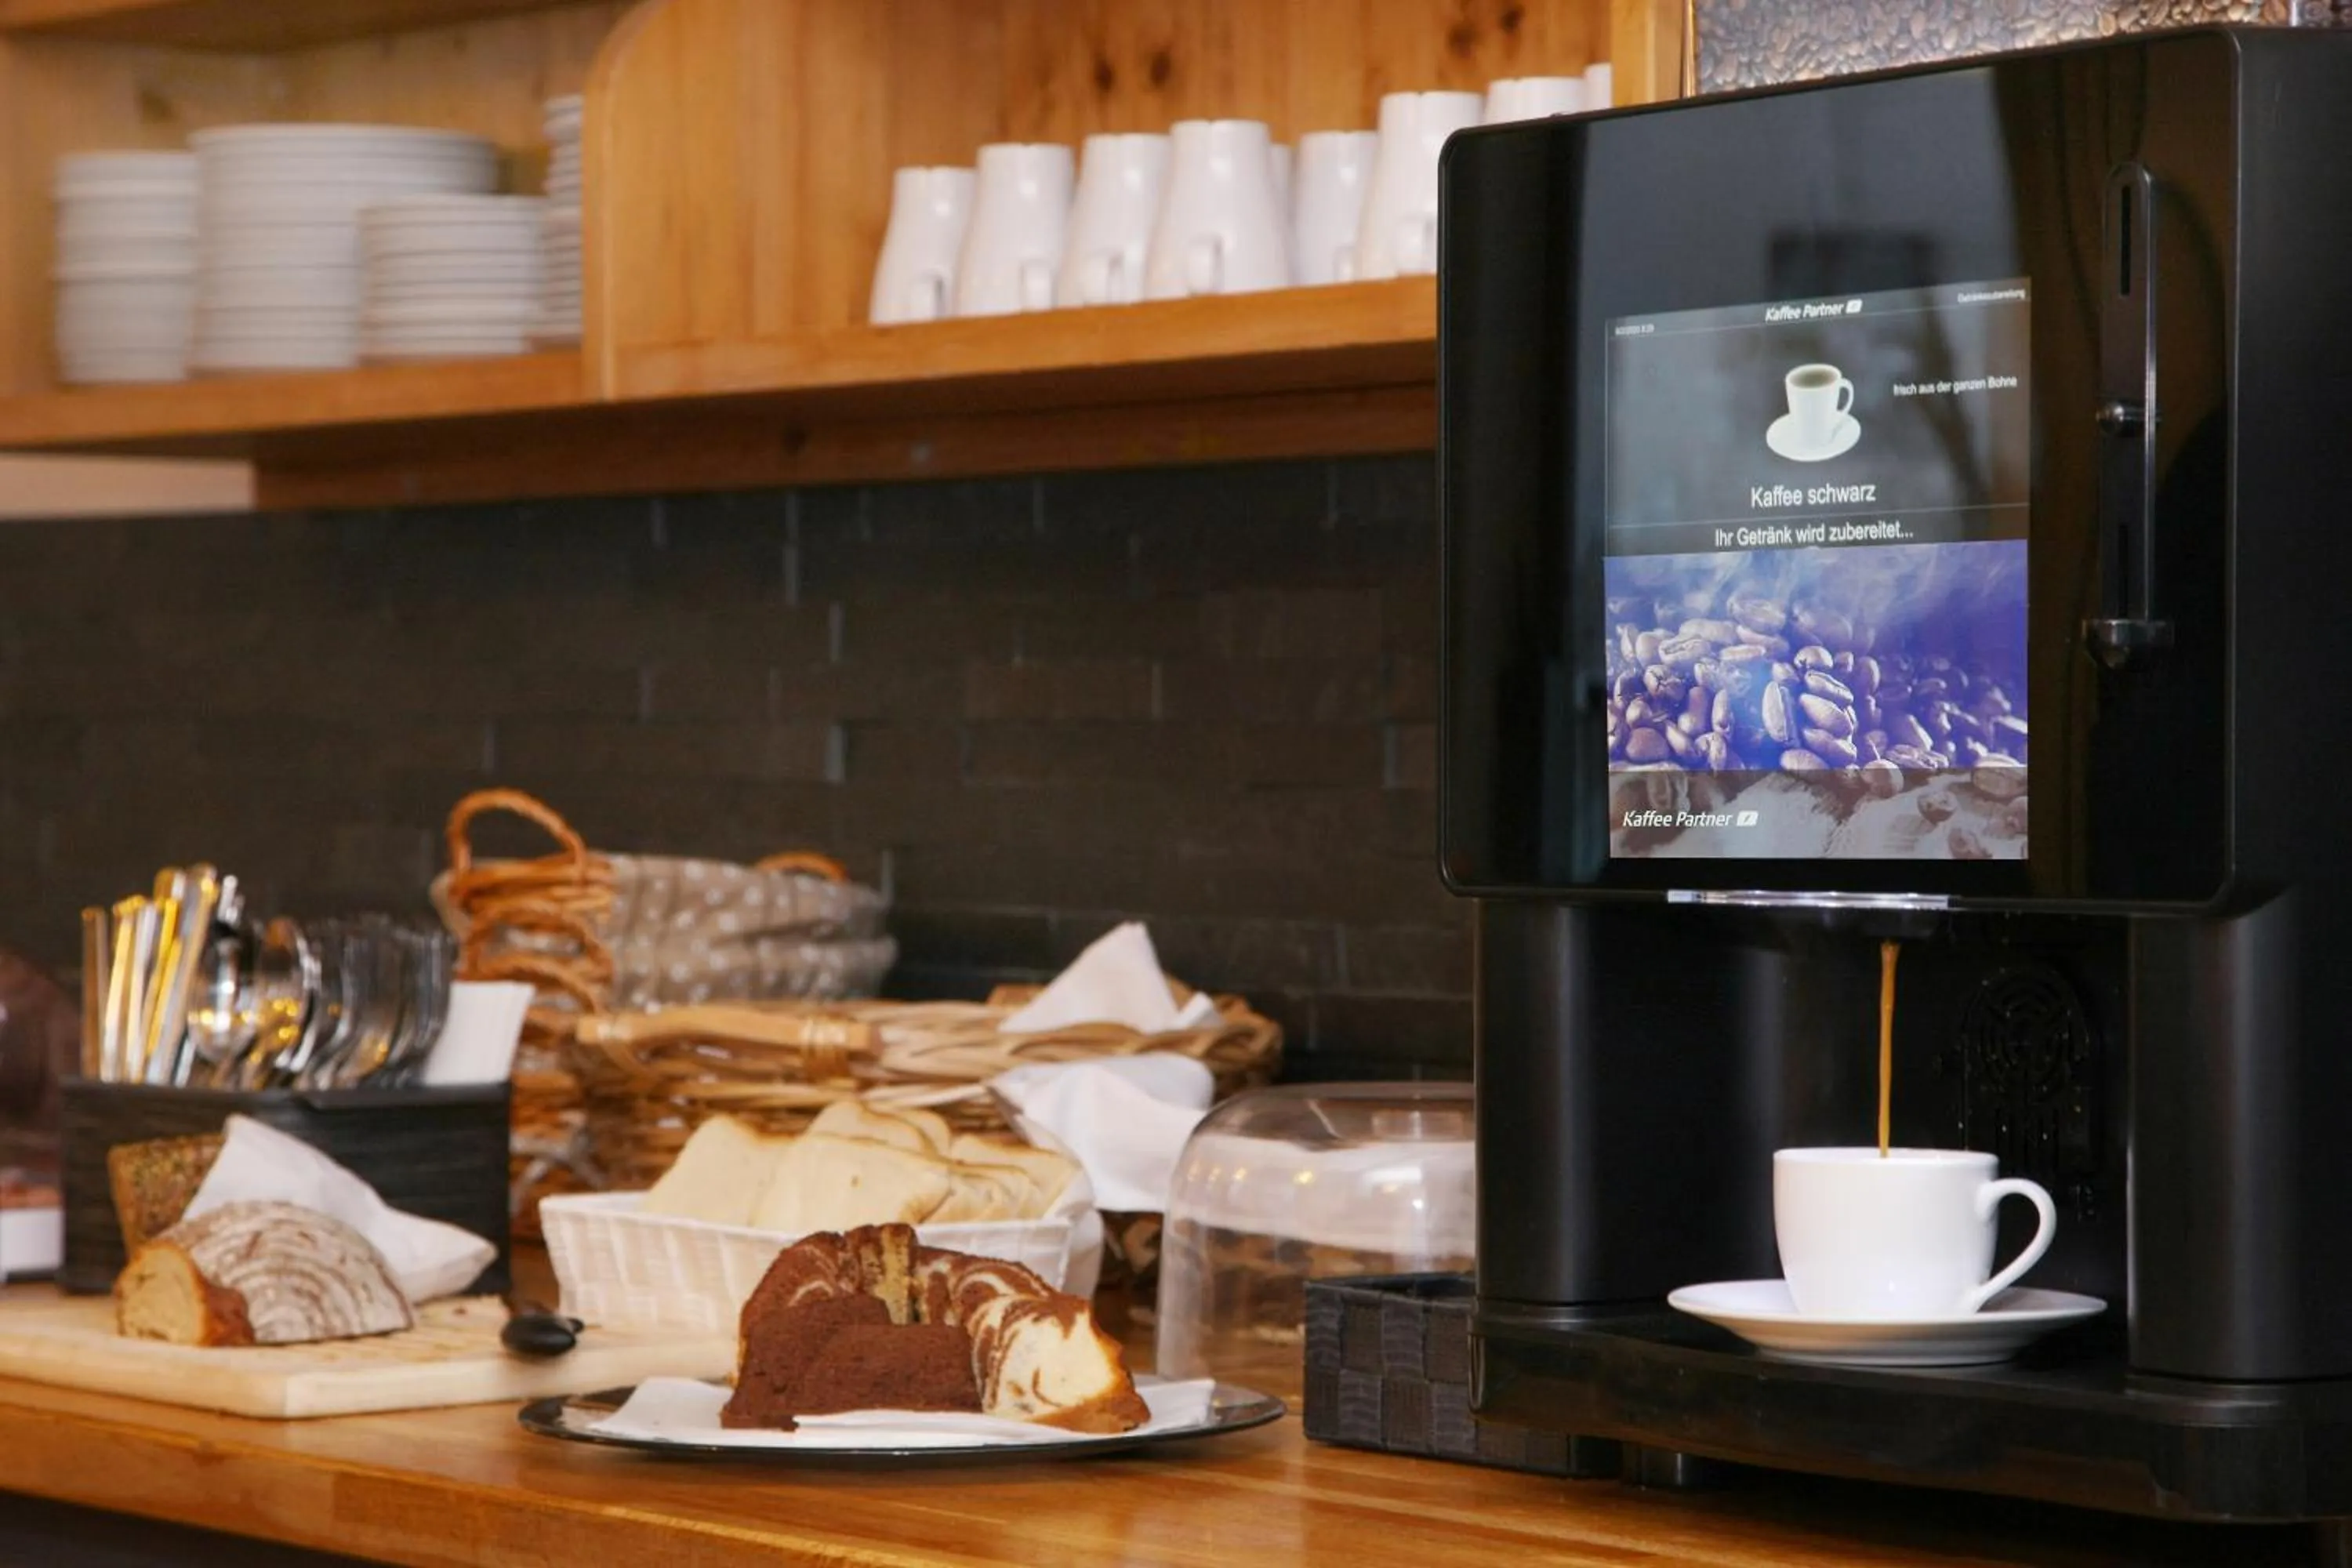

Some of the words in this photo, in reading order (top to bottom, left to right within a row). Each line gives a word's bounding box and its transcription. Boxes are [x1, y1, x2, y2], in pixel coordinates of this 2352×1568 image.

[1765, 303, 1802, 322] Kaffee
[1802, 302, 1844, 318] Partner
[1936, 380, 1952, 393] der
[1953, 379, 1986, 394] ganzen
[1987, 376, 2018, 390] Bohne
[1751, 484, 1803, 509] Kaffee
[1807, 482, 1876, 504] schwarz
[1715, 528, 1734, 547] Ihr
[1737, 525, 1793, 546] Getränk
[1795, 522, 1825, 543] wird
[1828, 520, 1914, 542] zubereitet...
[1623, 810, 1673, 827] Kaffee
[1675, 811, 1733, 827] Partner
